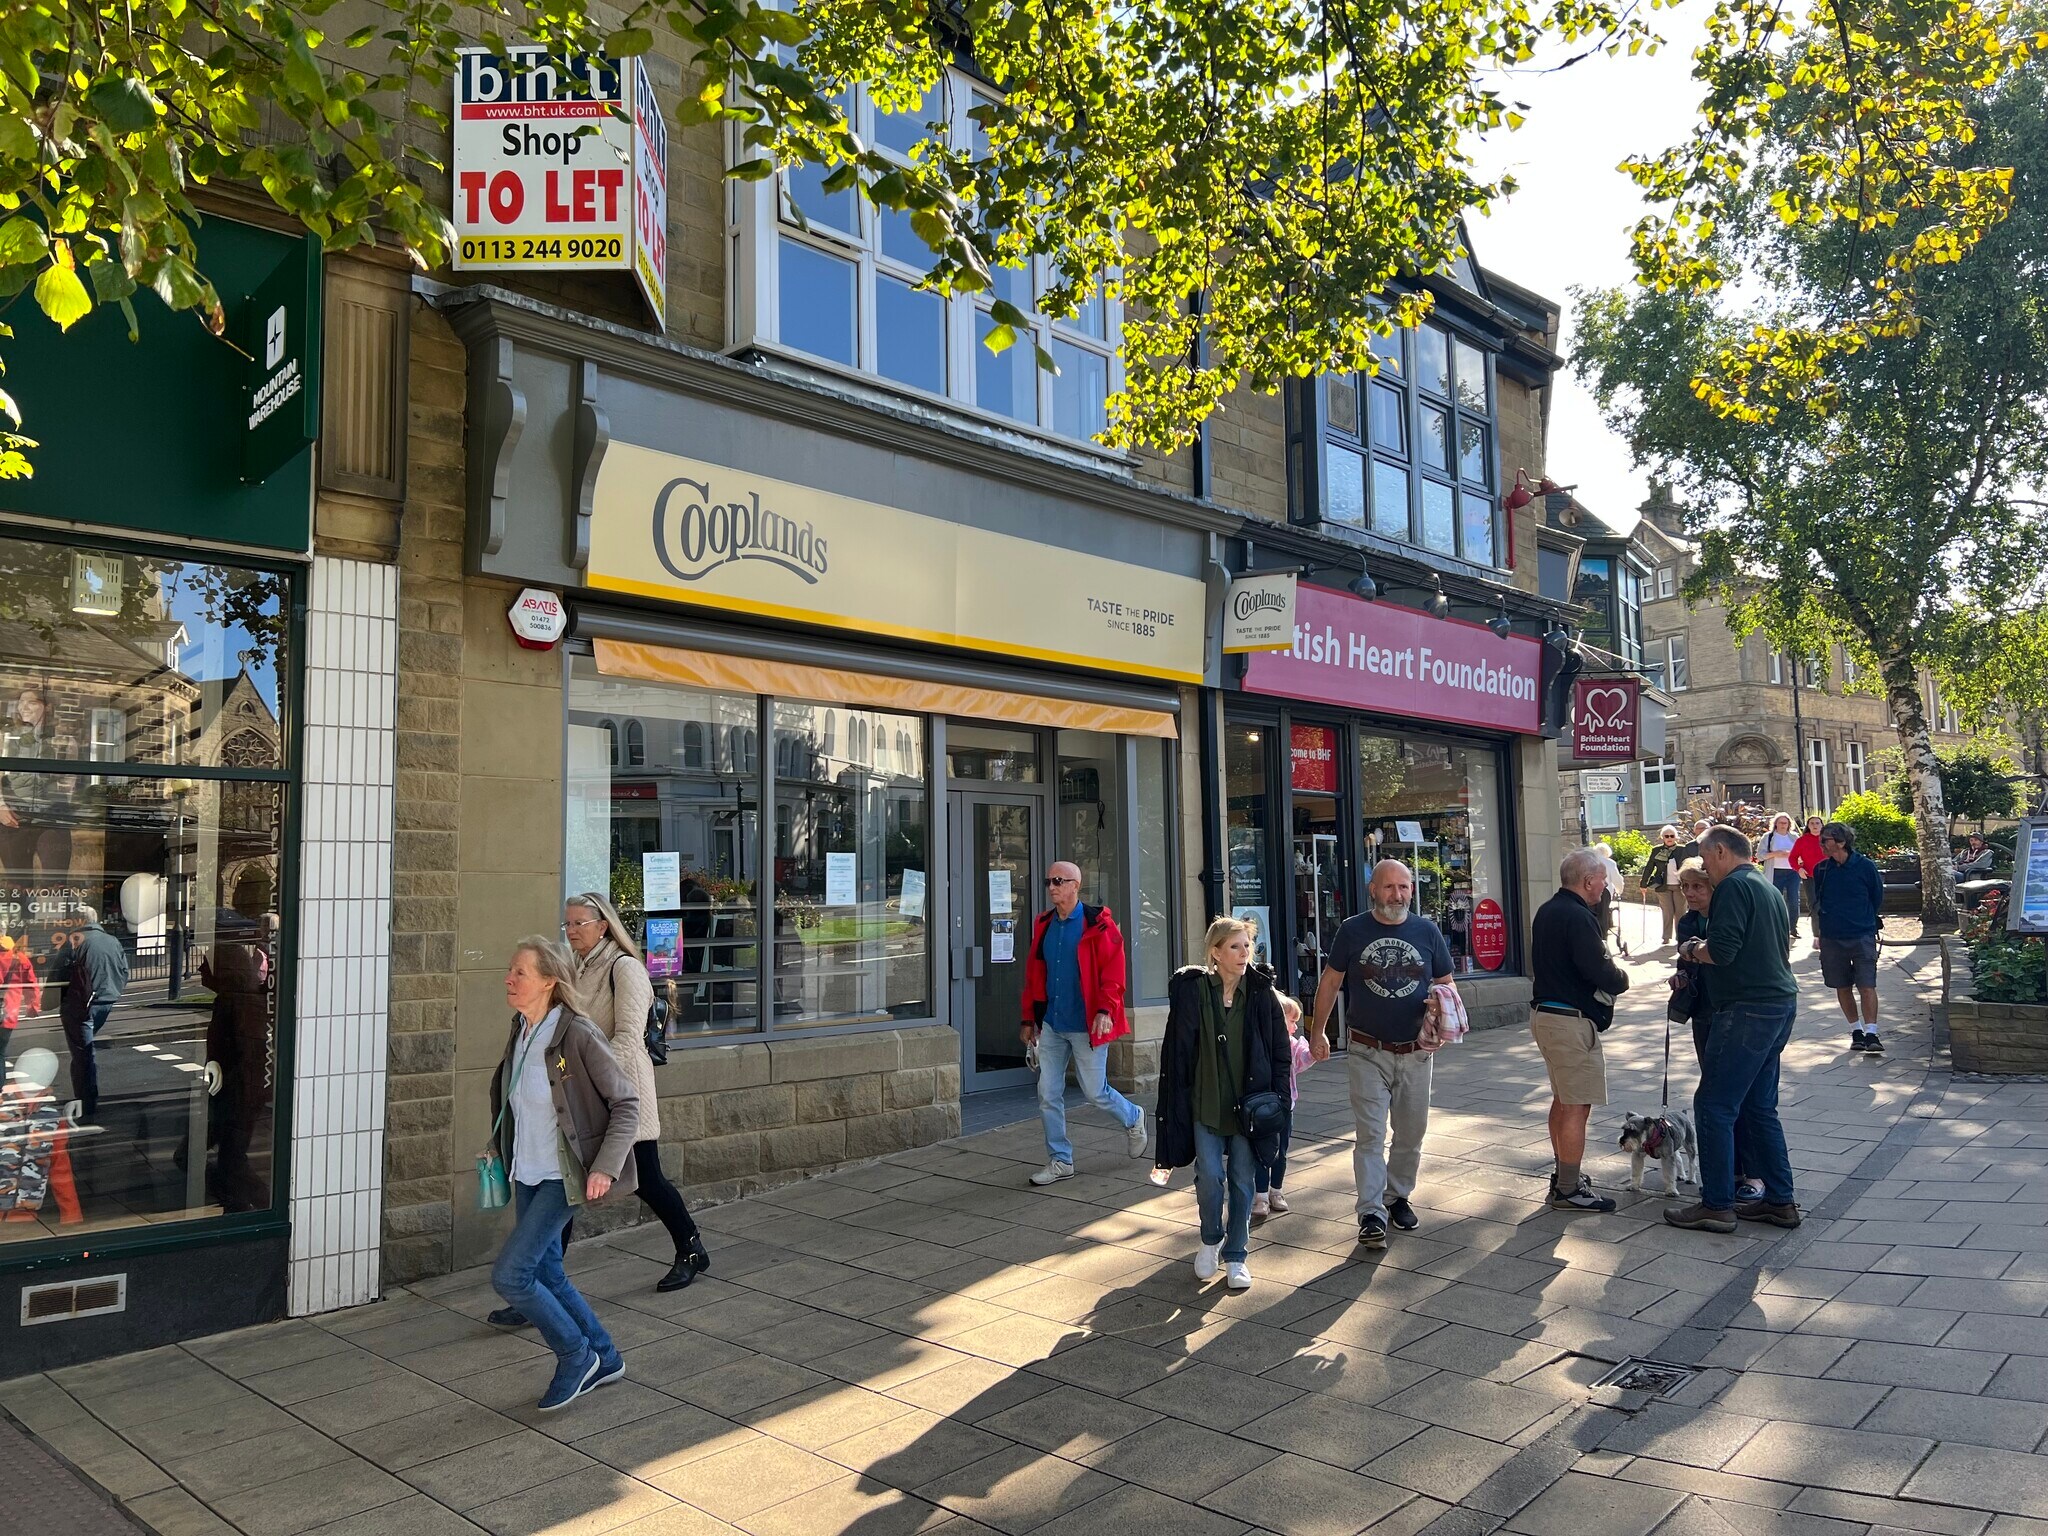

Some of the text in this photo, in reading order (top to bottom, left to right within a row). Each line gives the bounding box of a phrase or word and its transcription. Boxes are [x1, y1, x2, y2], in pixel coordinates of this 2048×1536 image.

[471, 53, 608, 102] bht
[486, 105, 597, 117] www.bht.uk.com
[502, 123, 581, 165] Shop
[460, 169, 624, 224] TO LET
[636, 174, 666, 284] TO LET
[462, 239, 622, 259] 0113 244 9020
[253, 358, 299, 409] MOUNTAIN
[248, 374, 302, 430] WAREHOUSE
[653, 477, 828, 584] Cooplands
[522, 598, 558, 616] ABATIS
[1087, 598, 1175, 626] TASTE THE PRIDE
[1234, 589, 1286, 621] Cooplands
[531, 615, 550, 623] 01472
[1107, 619, 1155, 637] SINCE 1885
[1271, 621, 1536, 701] tish Heart Foundation
[1580, 735, 1630, 743] British Heart
[1580, 743, 1630, 752] Foundation
[1309, 748, 1316, 759] to
[1317, 748, 1332, 761] BHF
[11, 889, 20, 898] &
[26, 889, 88, 898] WOMENS
[28, 902, 88, 913] GILETS
[1384, 939, 1413, 952] MONKEY
